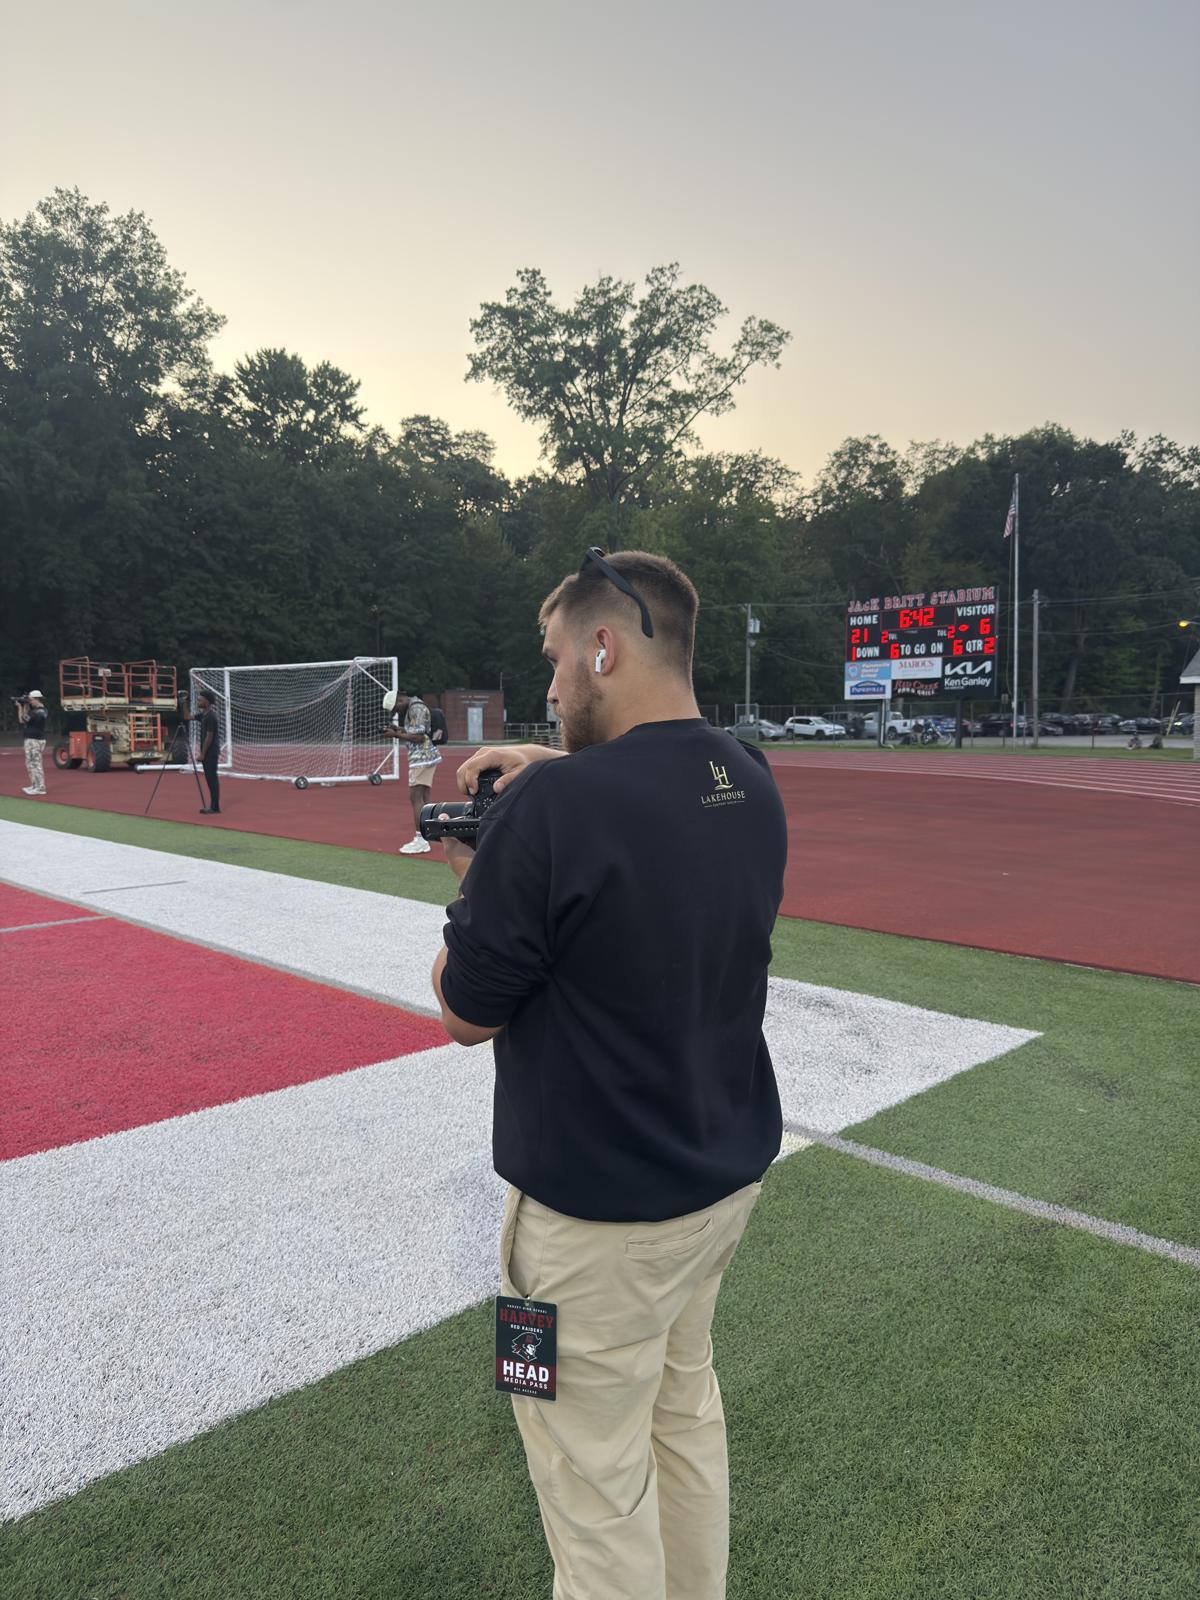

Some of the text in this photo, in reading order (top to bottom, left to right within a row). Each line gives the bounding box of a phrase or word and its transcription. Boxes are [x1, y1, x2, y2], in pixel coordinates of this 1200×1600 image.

[848, 586, 996, 613] JACK BRITT STADIUM
[956, 604, 995, 617] VISITOR
[850, 614, 878, 626] HOME
[899, 608, 934, 628] 6:42
[947, 626, 955, 639] 2
[980, 618, 990, 634] 6
[851, 628, 868, 644] 21
[881, 631, 888, 643] 2
[857, 646, 880, 658] DOWN
[890, 644, 900, 659] 6
[901, 642, 943, 655] TO GO ON
[953, 640, 963, 655] 6
[966, 640, 982, 652] QTR
[984, 637, 996, 654] 2
[852, 647, 856, 662] 1
[944, 676, 992, 688] Ken Ganley
[700, 790, 746, 804] LAKEHOUSE
[499, 1308, 554, 1328] HARVEY
[522, 1325, 543, 1334] RAIDERS
[503, 1360, 549, 1382] HEAD
[504, 1376, 548, 1390] MEDIA PASS
